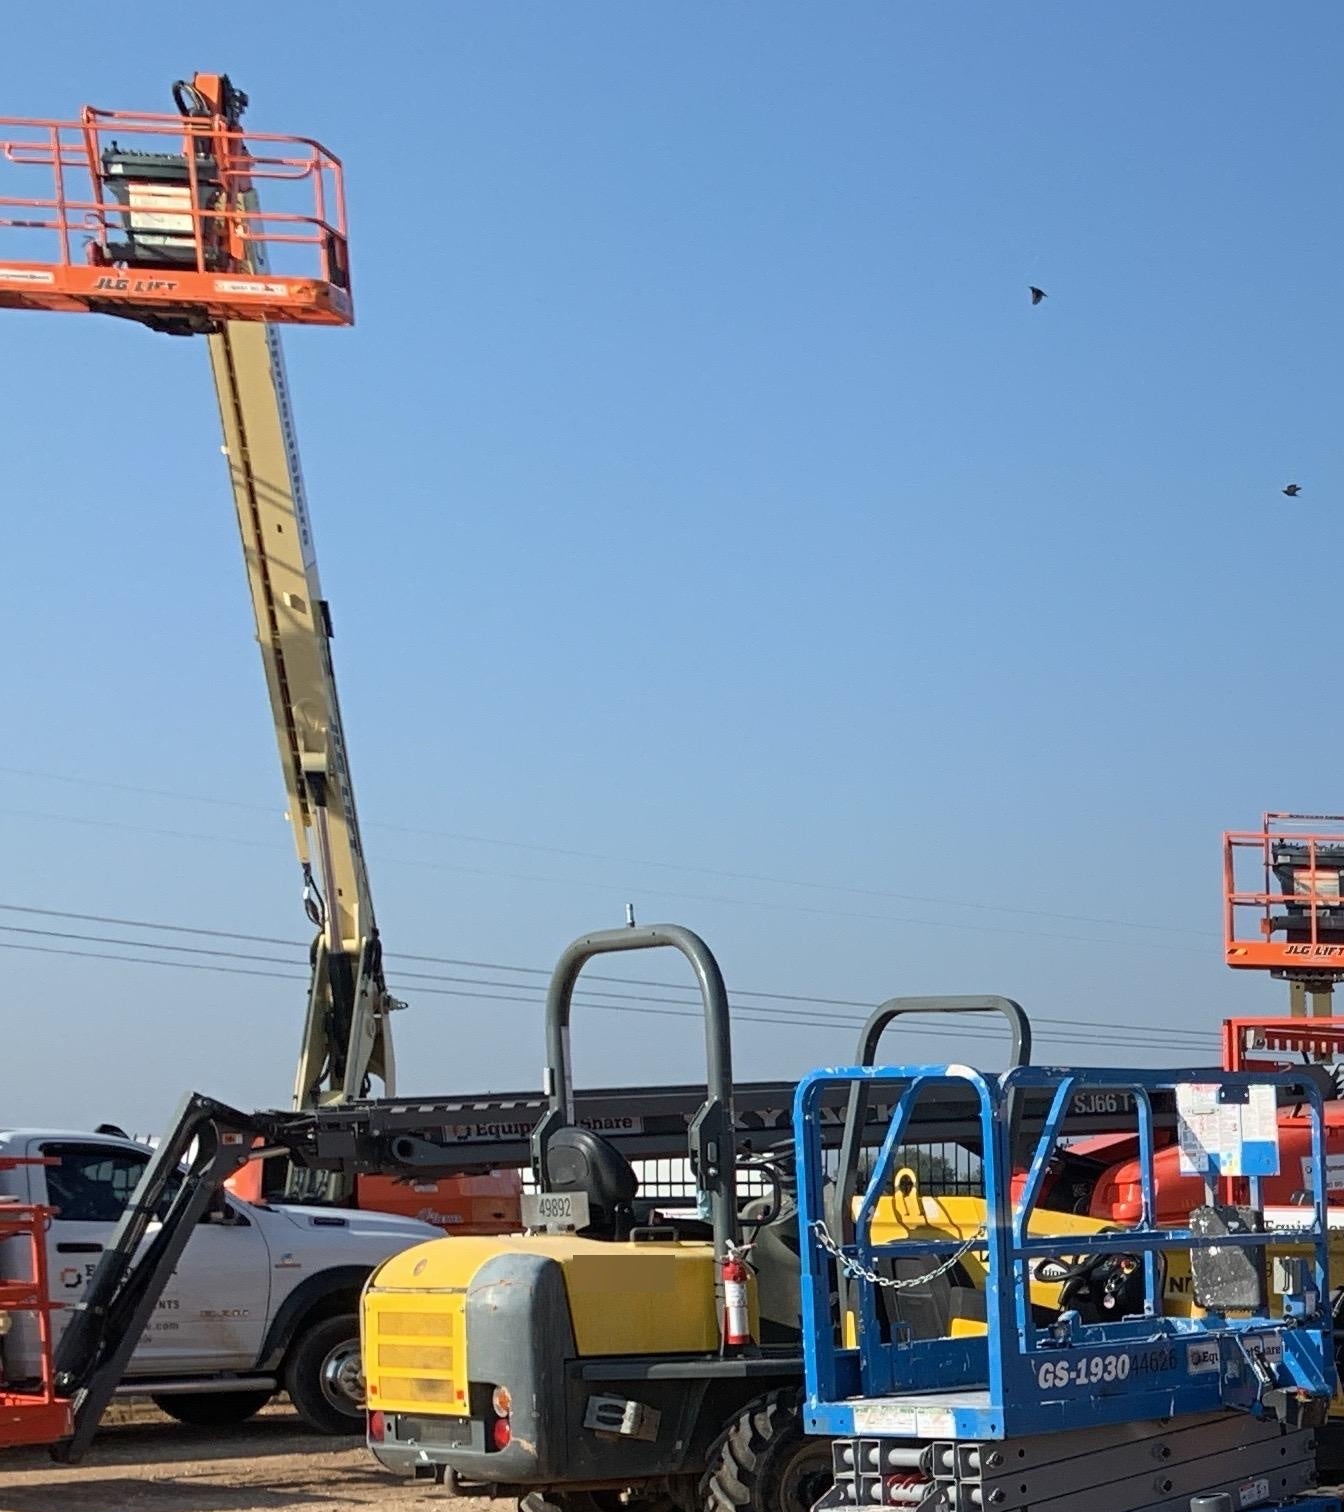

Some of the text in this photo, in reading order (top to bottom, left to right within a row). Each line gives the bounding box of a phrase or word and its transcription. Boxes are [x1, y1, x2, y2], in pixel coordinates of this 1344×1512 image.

[95, 277, 128, 290] JLG
[1284, 944, 1311, 955] JLG
[538, 1197, 572, 1217] 49892
[1038, 1353, 1130, 1389] GS-1930
